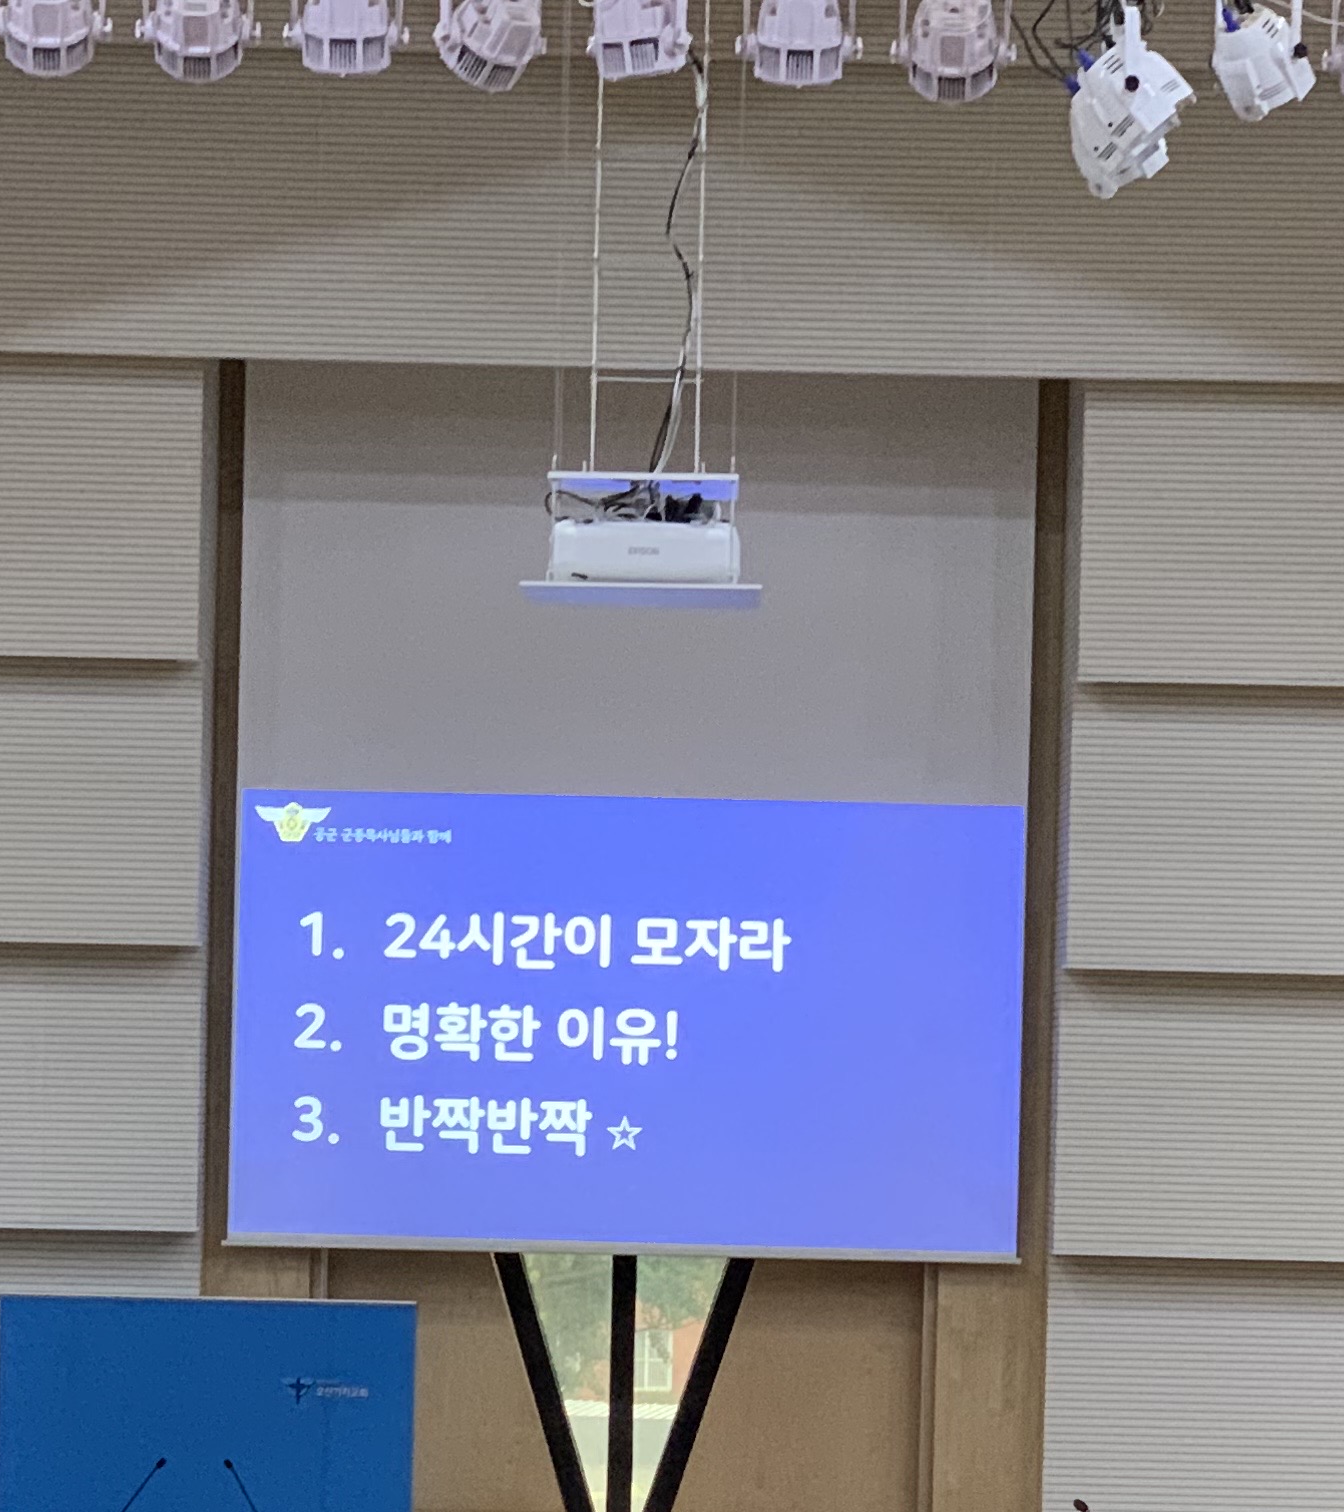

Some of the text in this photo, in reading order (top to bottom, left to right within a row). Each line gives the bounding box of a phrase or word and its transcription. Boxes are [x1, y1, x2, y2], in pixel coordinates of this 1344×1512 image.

[314, 827, 338, 843] 공군
[300, 912, 793, 974] 1. 24시간이 모자라
[294, 1002, 680, 1067] 2. 명확한 이유!
[292, 1095, 594, 1158] 3. 반짝반짝
